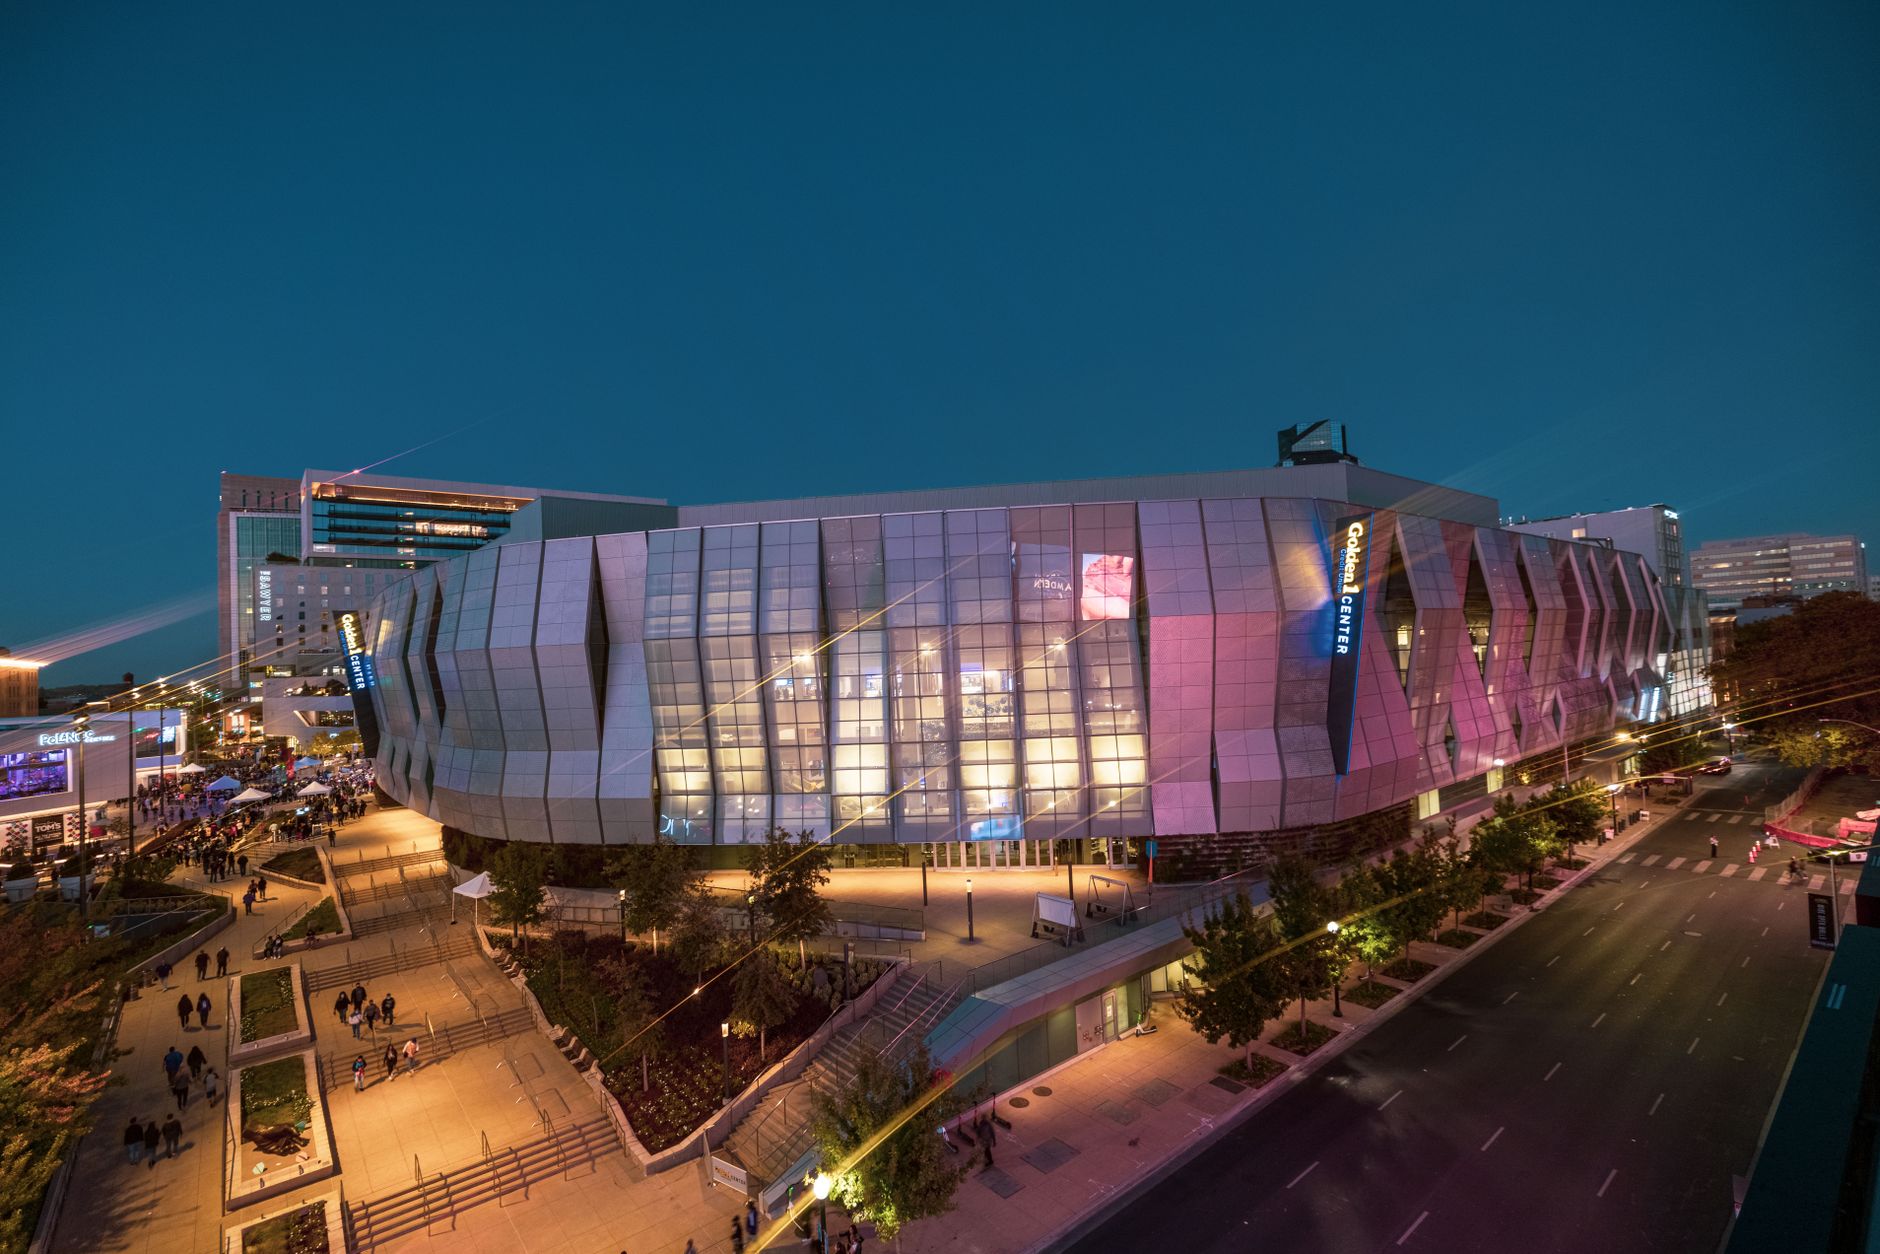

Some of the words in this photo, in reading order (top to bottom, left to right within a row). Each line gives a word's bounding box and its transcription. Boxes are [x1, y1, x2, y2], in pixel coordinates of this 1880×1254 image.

[260, 576, 271, 621] SAWYER
[1336, 595, 1353, 654] CENTER
[350, 655, 366, 690] CENTER
